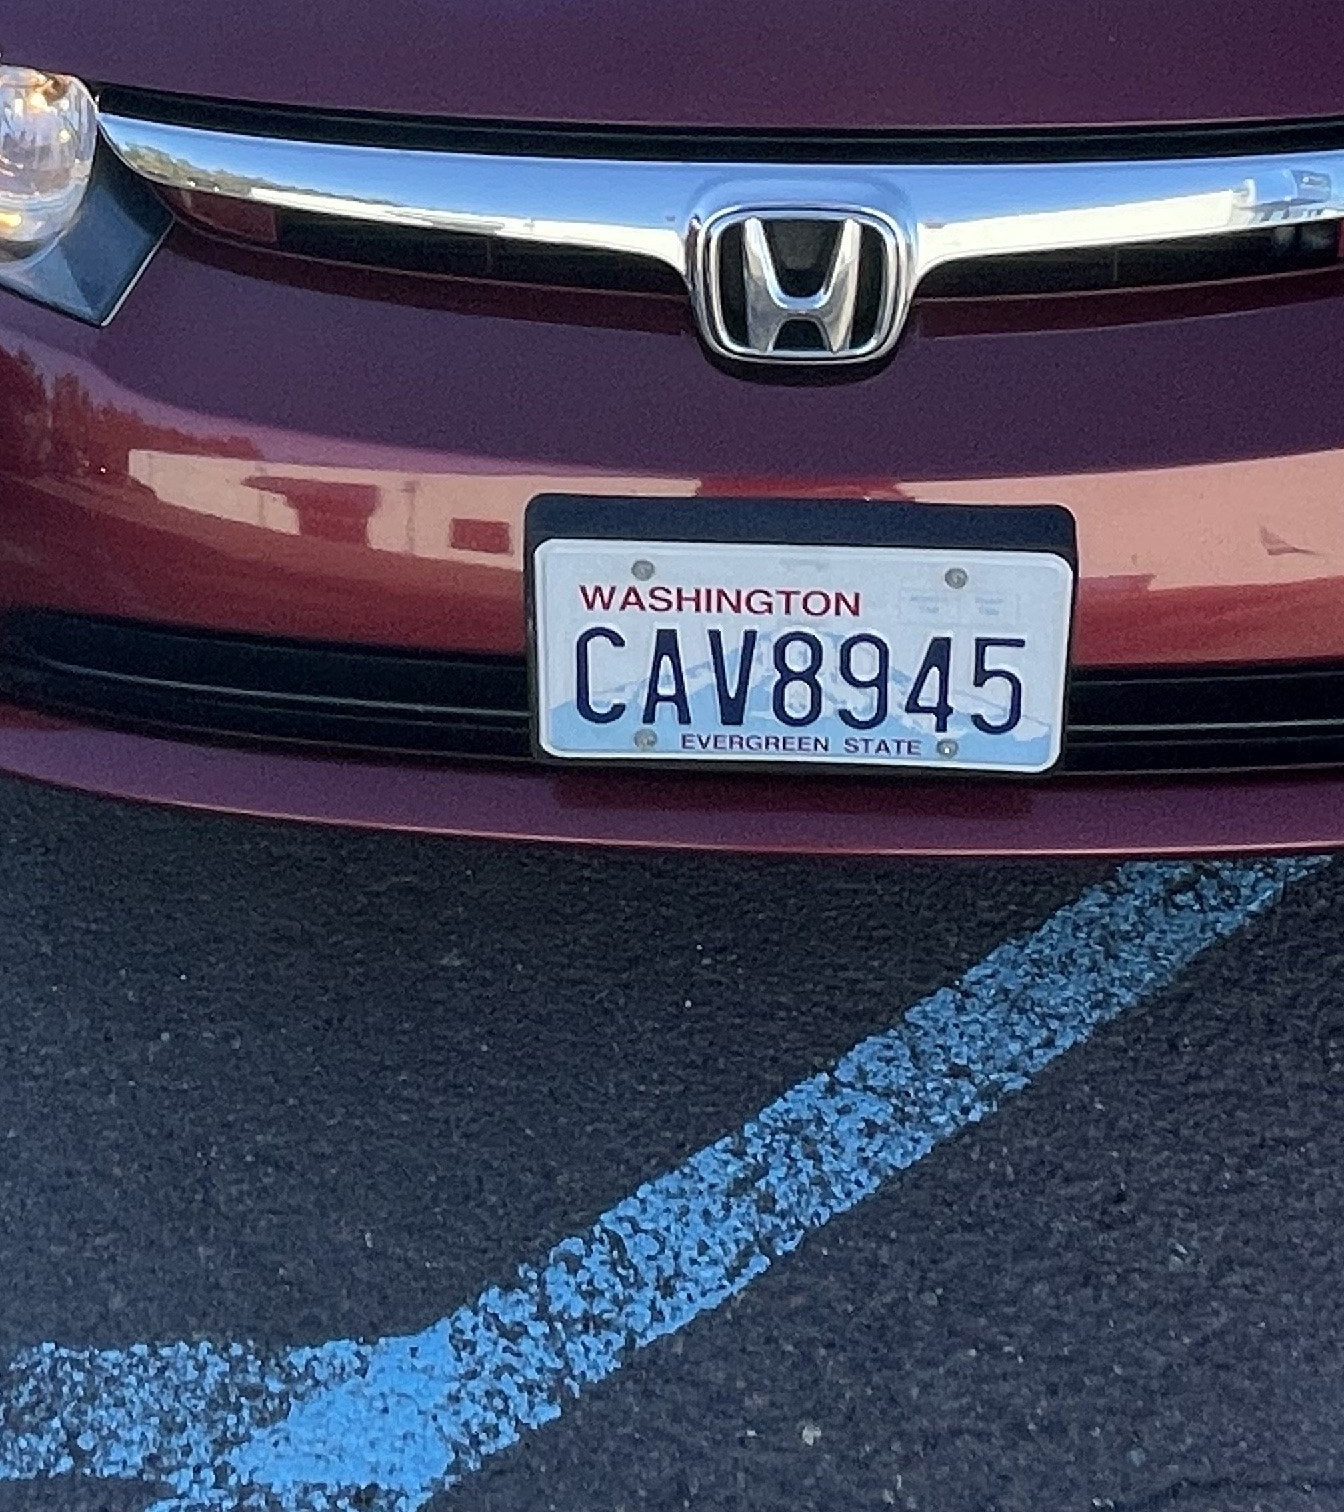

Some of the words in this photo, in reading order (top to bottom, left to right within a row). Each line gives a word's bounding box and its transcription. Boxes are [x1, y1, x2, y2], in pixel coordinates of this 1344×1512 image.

[579, 584, 861, 617] WASHINGTON
[576, 626, 1026, 736] CAV8945
[681, 733, 830, 752] EVERGREEN
[843, 738, 922, 756] STATE
